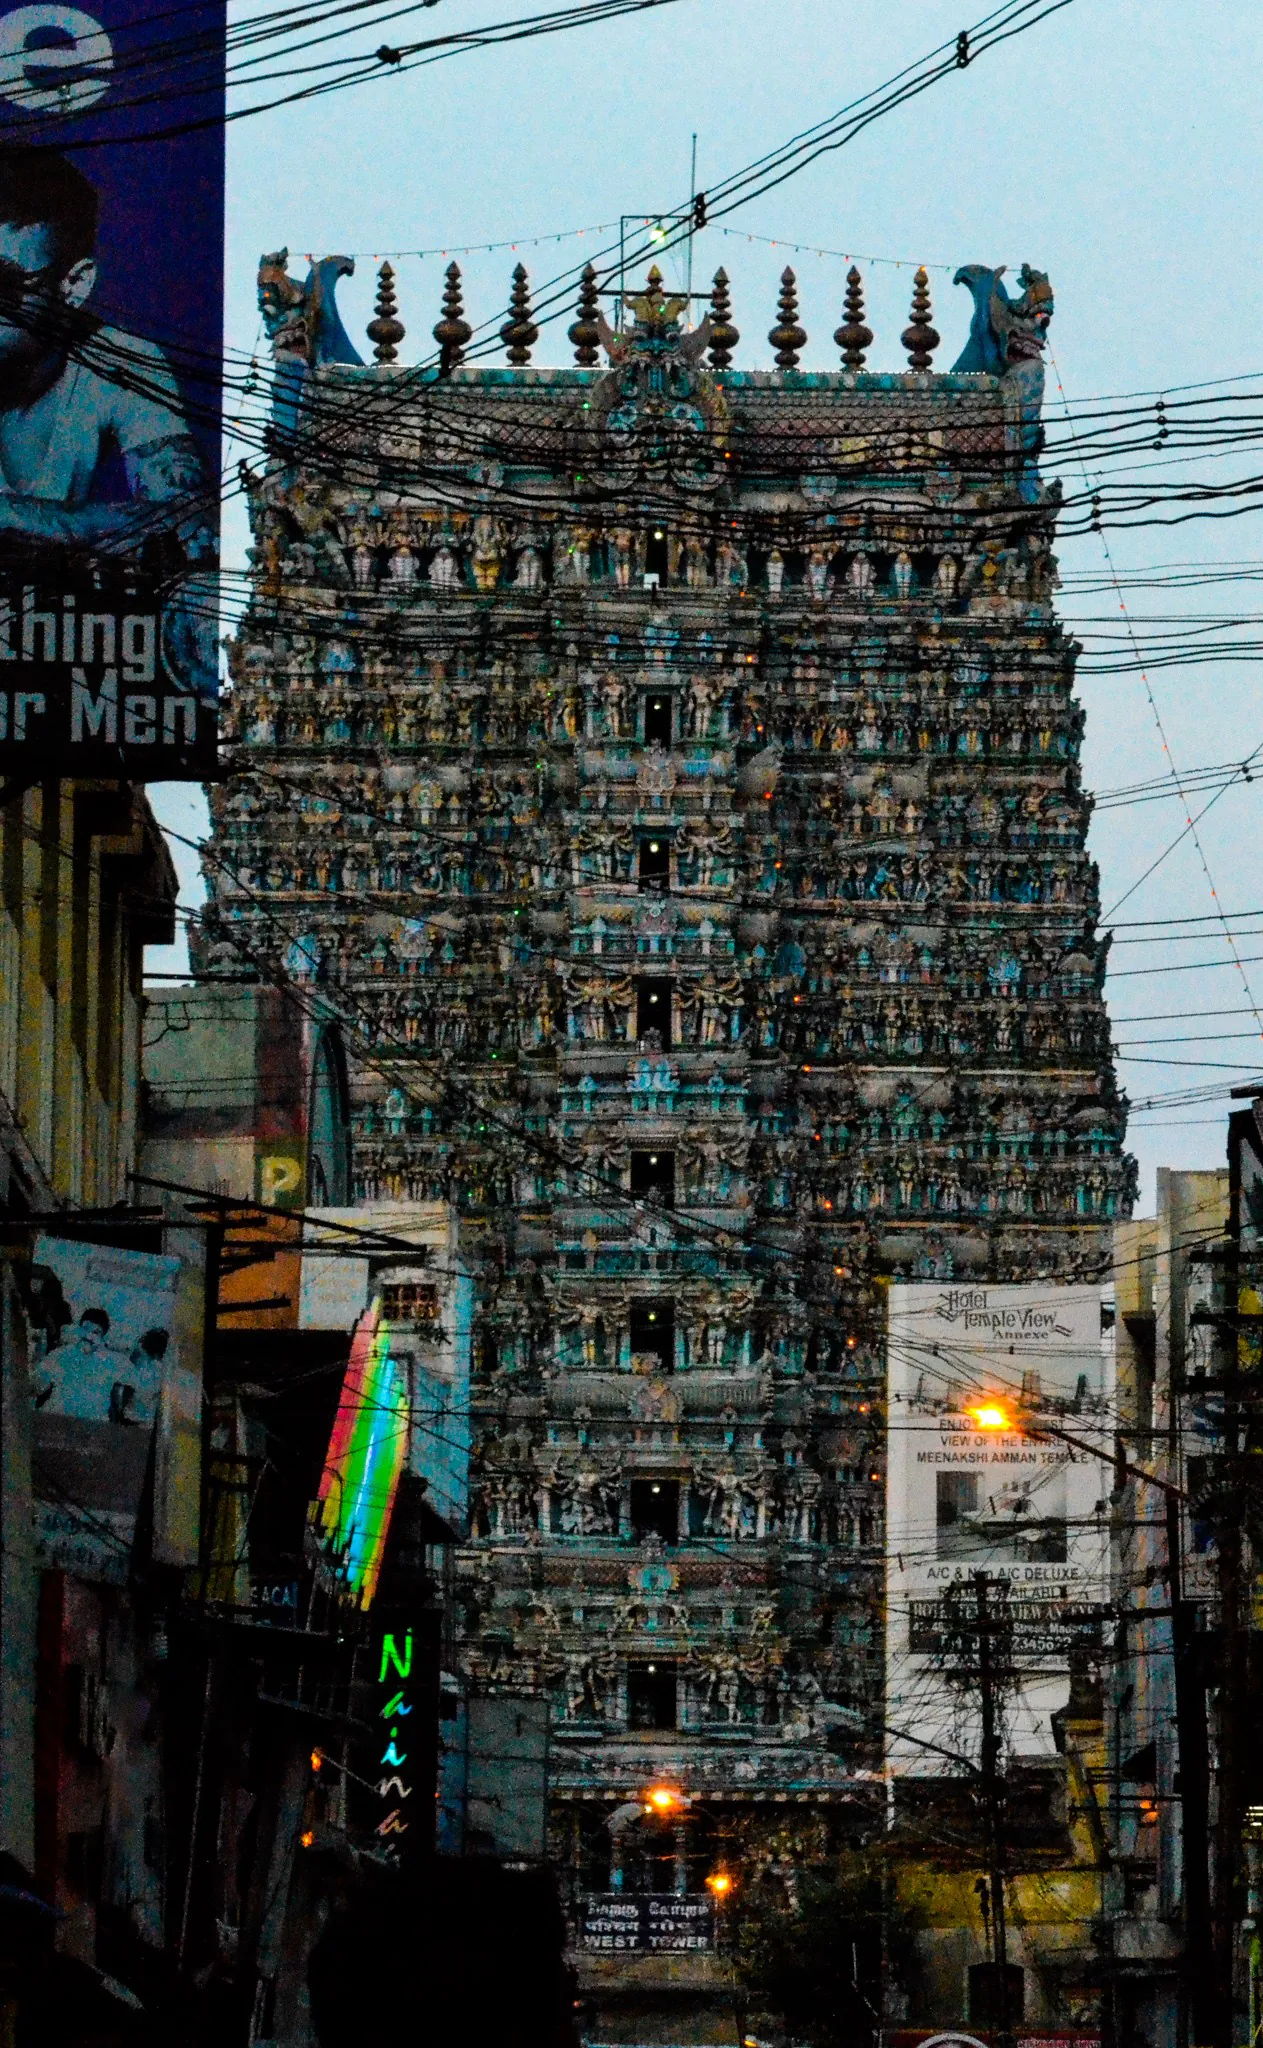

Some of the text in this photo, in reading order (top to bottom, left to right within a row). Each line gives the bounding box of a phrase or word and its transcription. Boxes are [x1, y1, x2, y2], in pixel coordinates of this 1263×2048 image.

[70, 667, 197, 744] Men
[948, 1290, 987, 1311] Hotel
[963, 1308, 1057, 1331] Temple View
[993, 1329, 1049, 1340] Annexe
[940, 1436, 971, 1447] VIEW
[974, 1436, 988, 1447] OF
[993, 1436, 1017, 1447] THE
[916, 1452, 1088, 1465] MEENAKSHI AMMAN TEMPLE
[927, 1567, 950, 1579] A/C
[954, 1566, 963, 1580] &
[997, 1567, 1020, 1580] A/C
[1024, 1567, 1079, 1581] DELUXE
[584, 1935, 709, 1948] WEST TOWER
